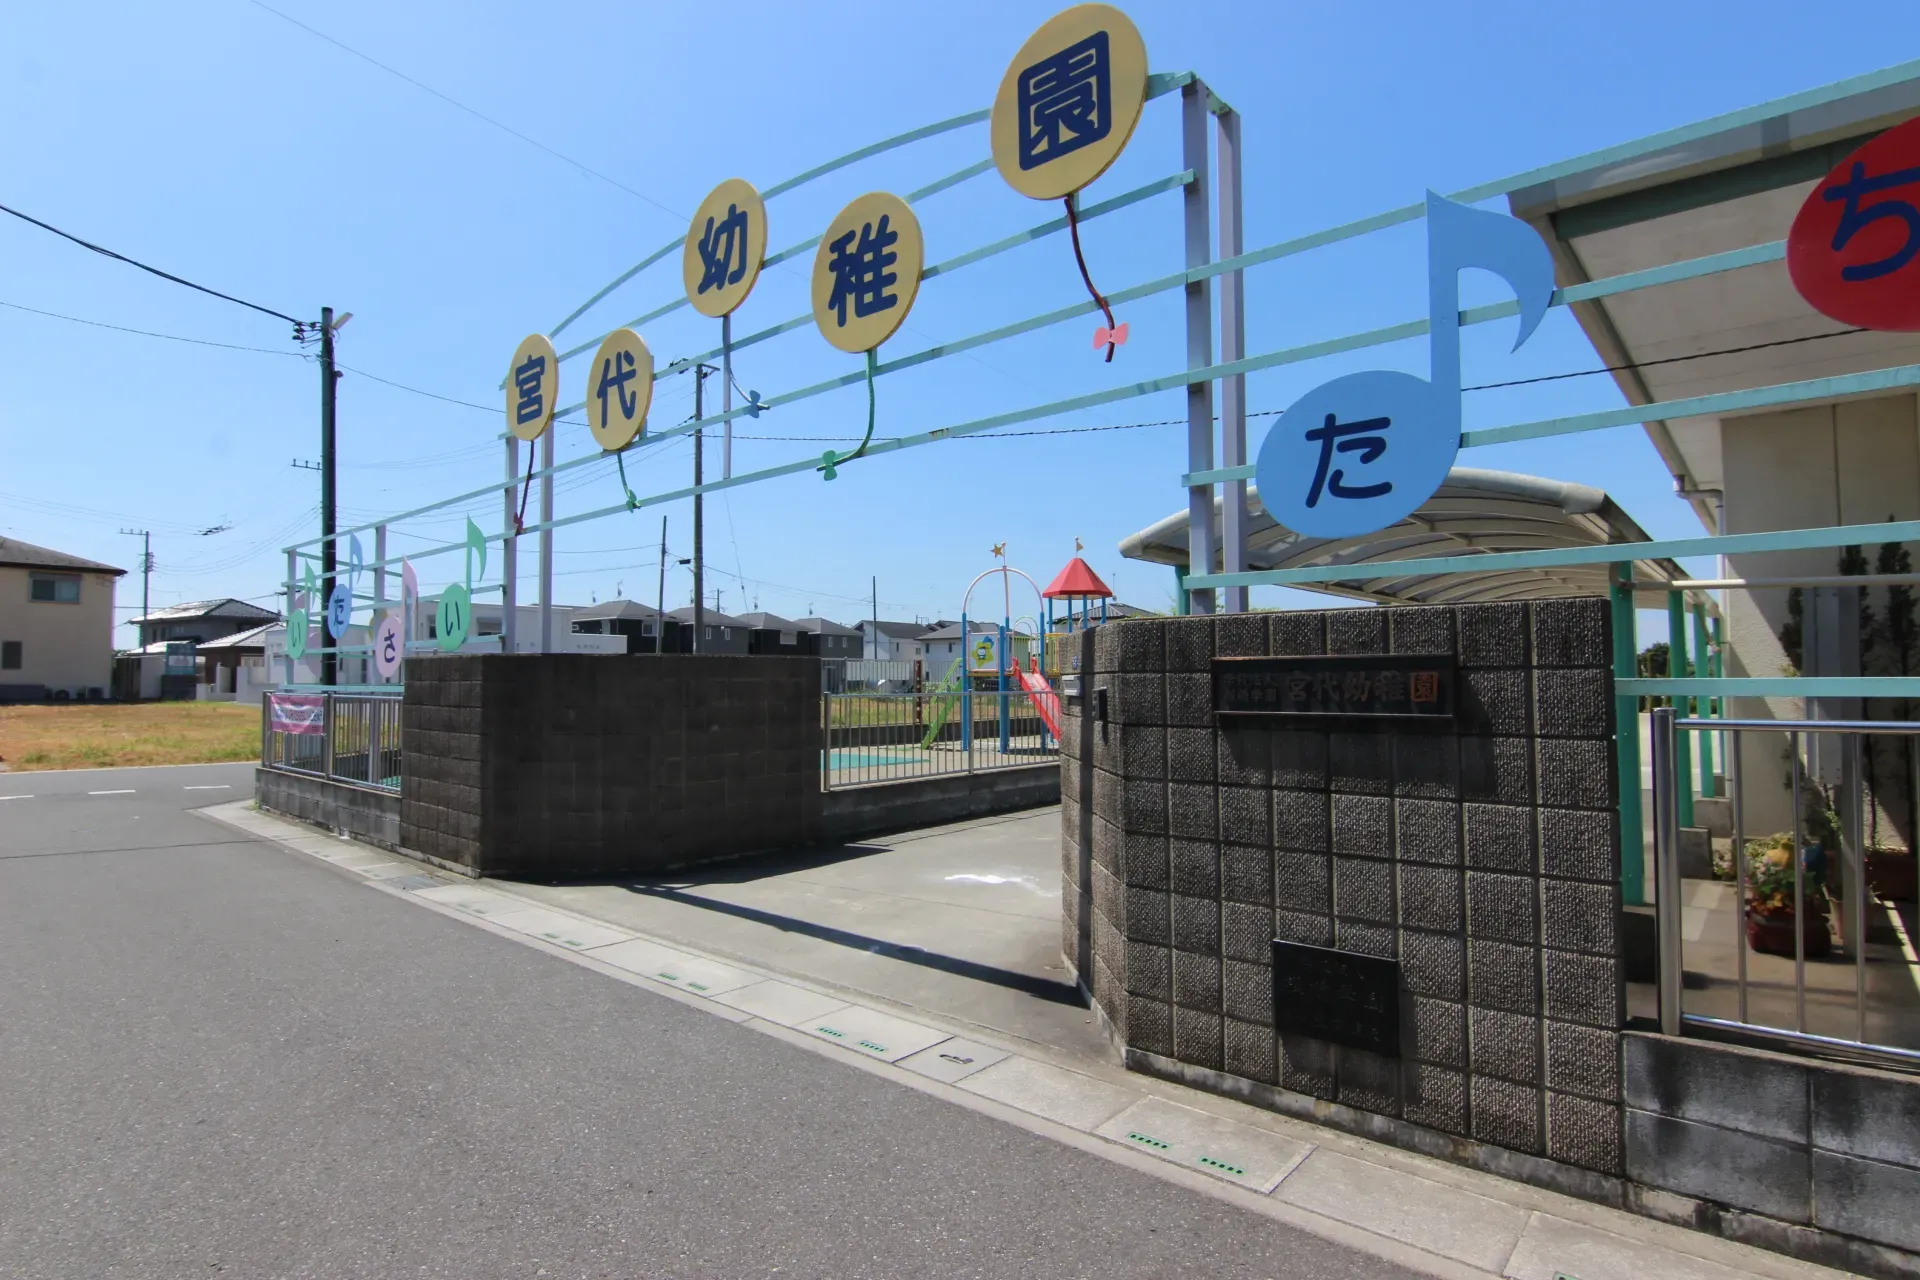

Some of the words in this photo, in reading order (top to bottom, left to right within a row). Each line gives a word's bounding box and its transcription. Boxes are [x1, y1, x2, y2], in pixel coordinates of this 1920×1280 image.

[515, 354, 546, 426] 宮
[596, 350, 638, 429] 代
[697, 203, 748, 295] 幼
[827, 214, 899, 328] 稚
[1017, 30, 1113, 172] 園
[1304, 412, 1393, 509] た
[1822, 160, 1920, 282] ち
[333, 596, 346, 625] た
[382, 628, 396, 664] さ
[445, 601, 461, 636] い
[1285, 669, 1440, 704] 宮代幼稚園
